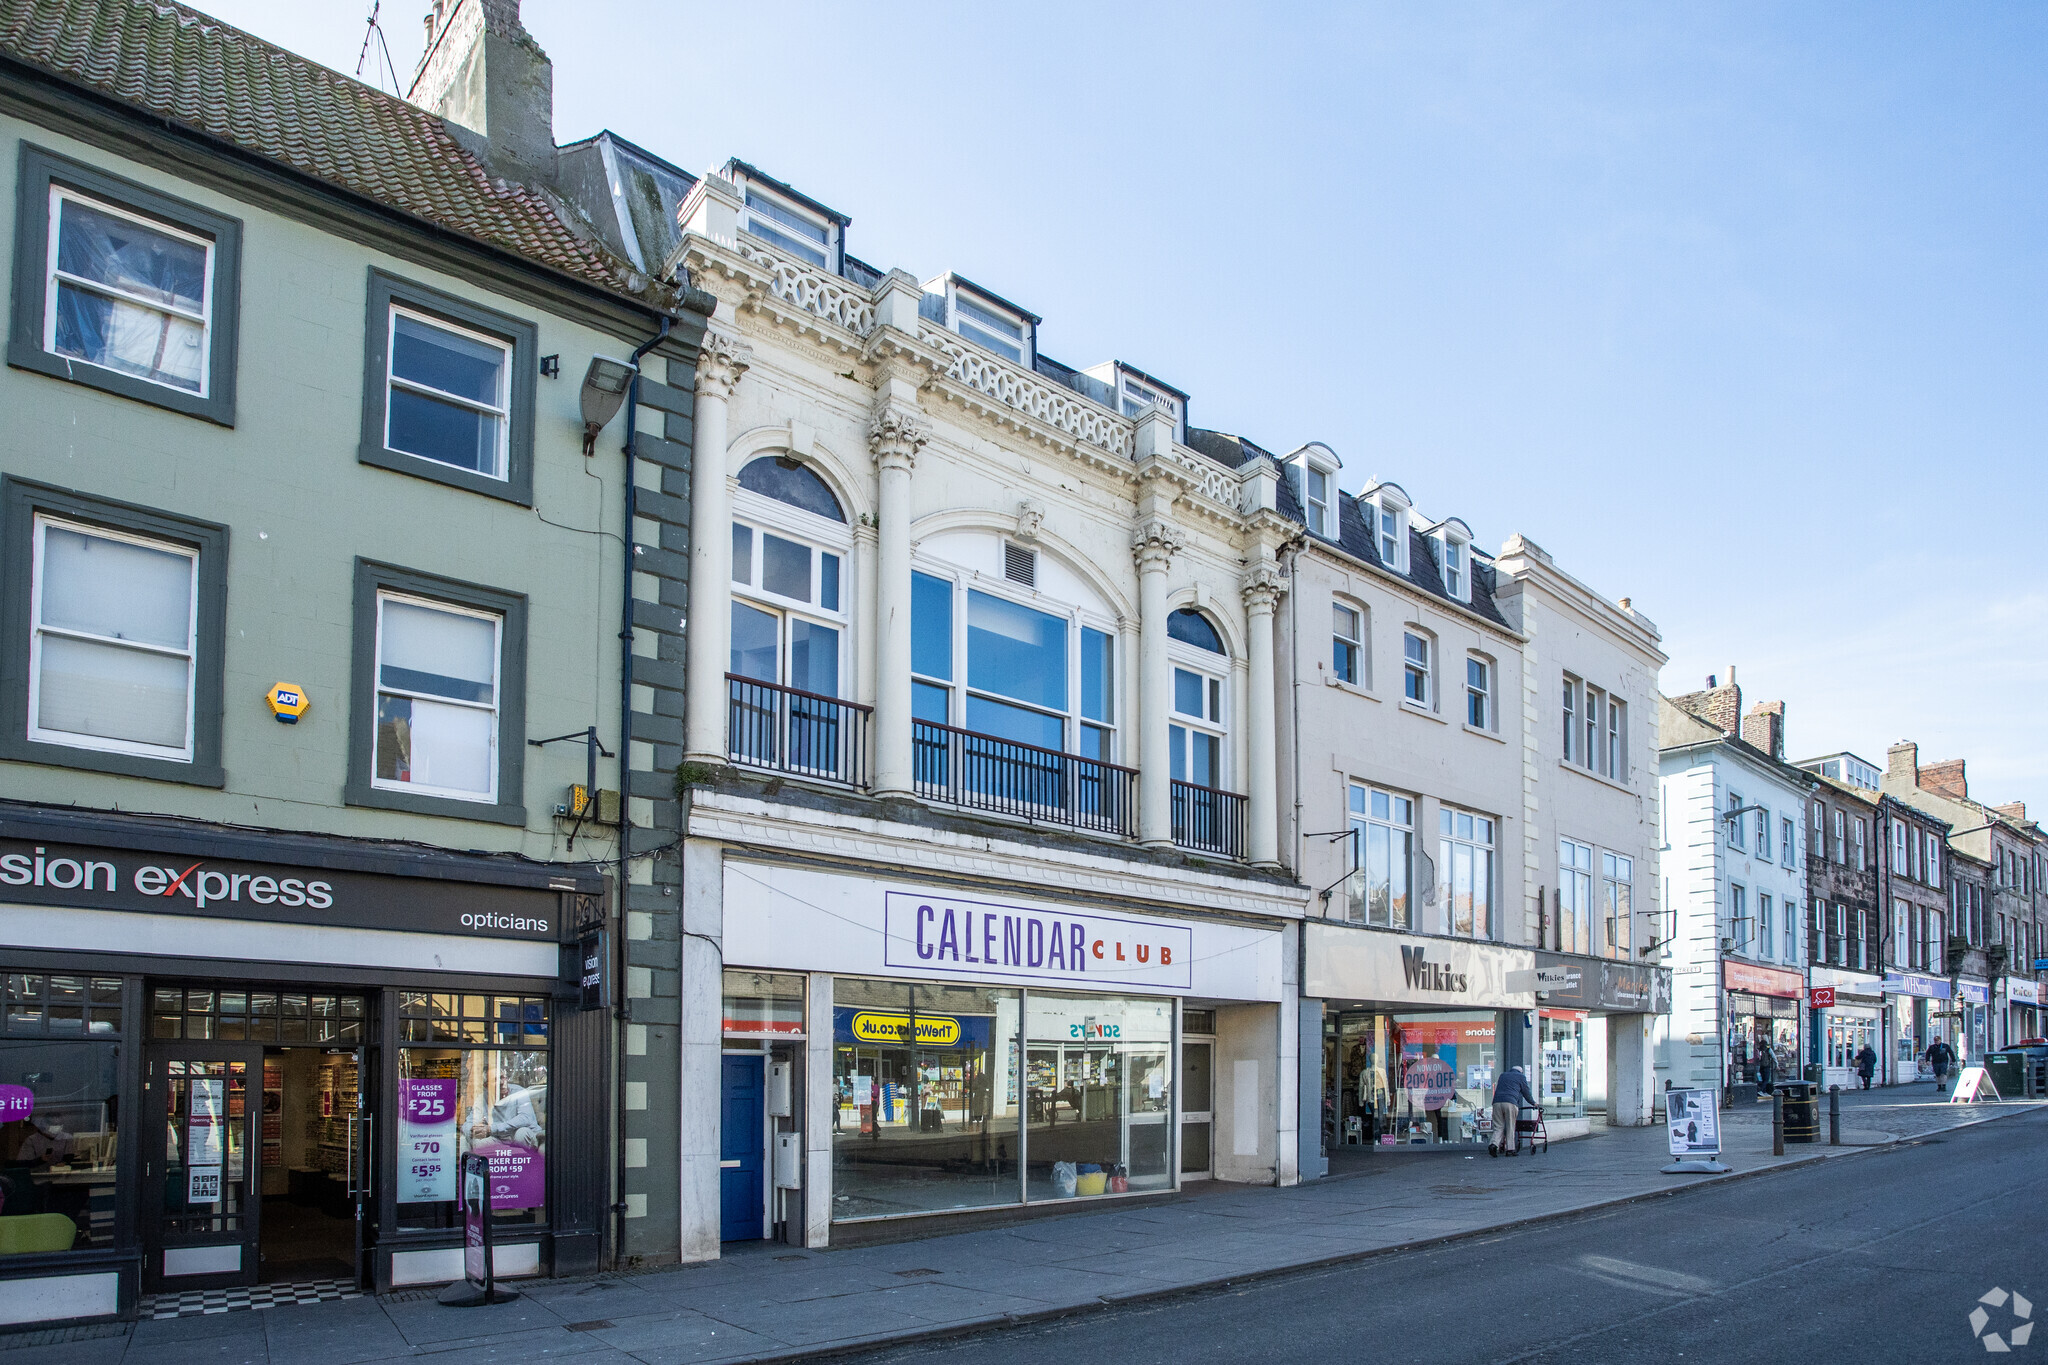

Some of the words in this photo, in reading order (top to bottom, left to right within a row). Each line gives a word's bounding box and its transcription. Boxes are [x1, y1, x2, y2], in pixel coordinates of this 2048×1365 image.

[277, 693, 299, 705] ADT
[134, 861, 334, 909] express
[460, 911, 549, 932] opticians
[916, 904, 1086, 972] CALENDAR
[1092, 939, 1172, 966] CLUB
[584, 955, 599, 970] vision
[1400, 944, 1468, 993] Wilkies
[1903, 976, 1933, 996] WHSmith
[1416, 1064, 1432, 1072] NOW
[1432, 1063, 1442, 1072] ON
[1545, 1053, 1557, 1068] TO
[1557, 1053, 1572, 1068] LET
[1406, 1073, 1434, 1089] 20%
[1436, 1072, 1455, 1088] OFF
[10, 1096, 28, 1110] it!
[408, 1099, 445, 1116] £25
[414, 1141, 440, 1154] £70
[495, 1149, 512, 1157] THE
[411, 1164, 442, 1177] £5.95
[489, 1165, 508, 1173] ROM
